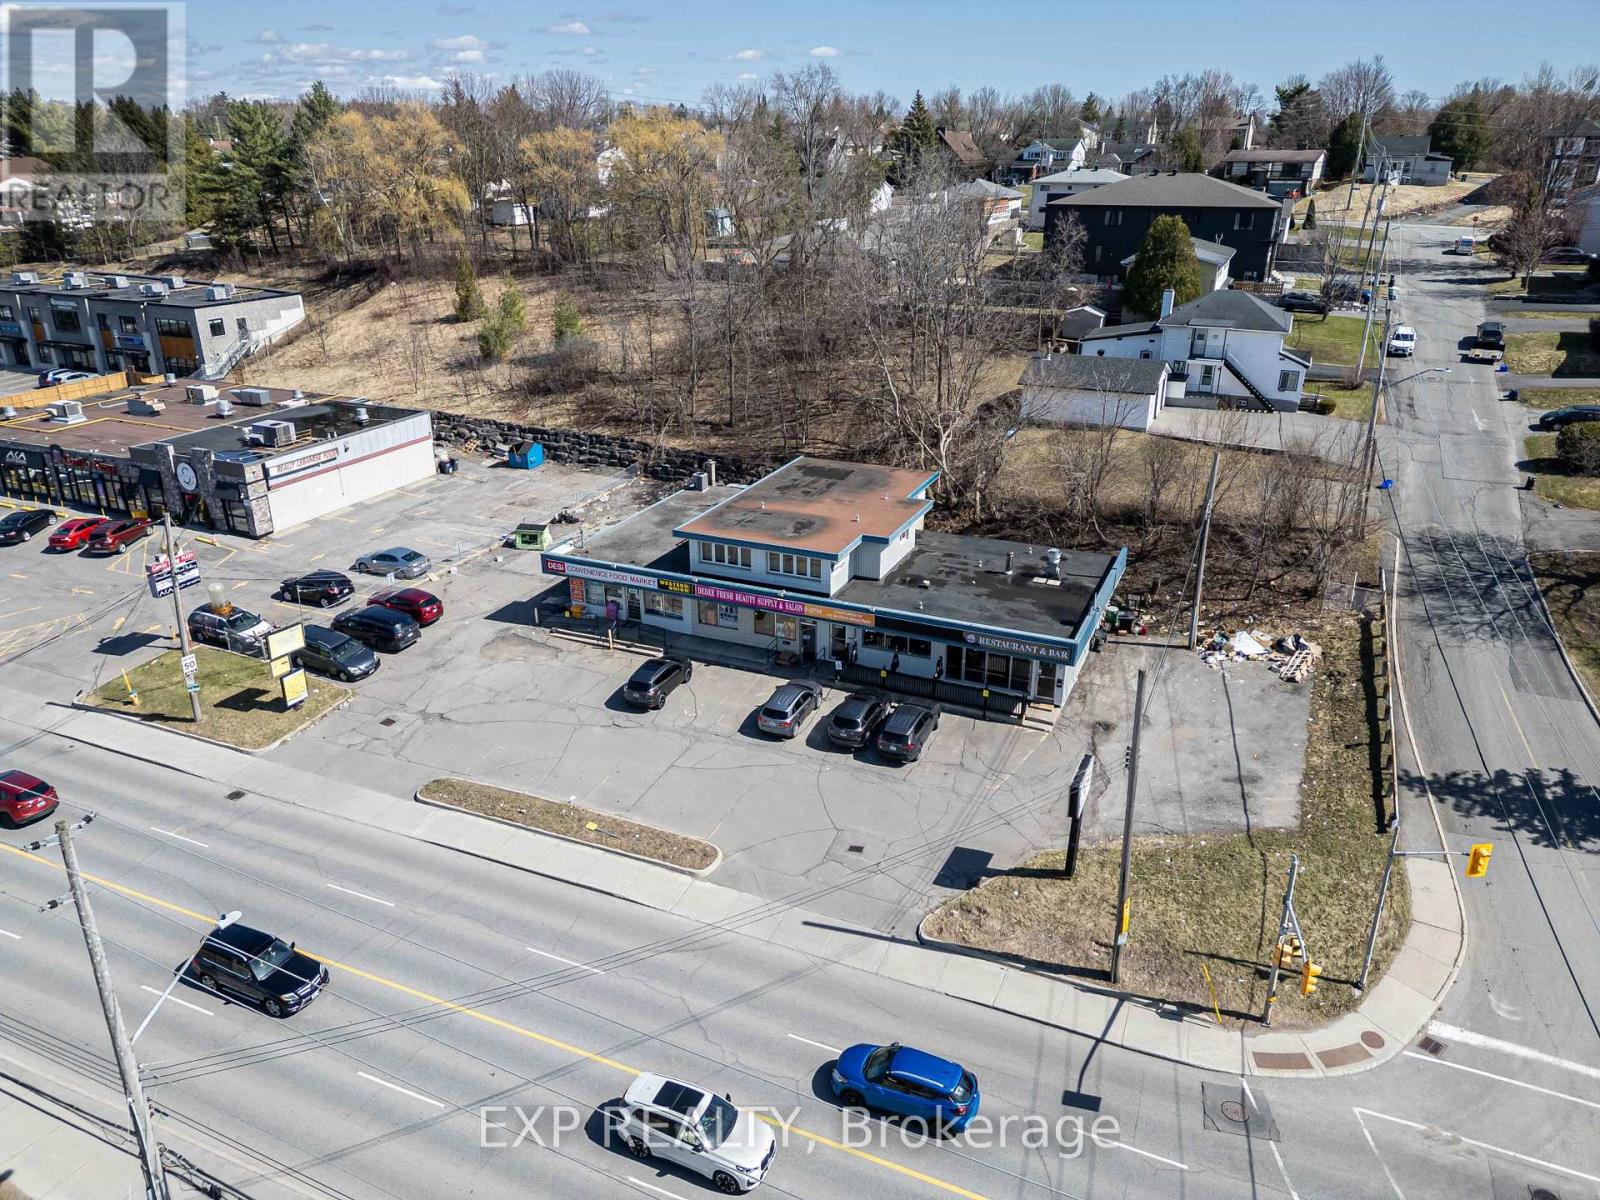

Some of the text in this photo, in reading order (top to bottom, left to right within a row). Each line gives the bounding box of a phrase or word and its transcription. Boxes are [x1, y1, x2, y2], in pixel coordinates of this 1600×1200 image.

[547, 561, 565, 570] DESI
[567, 565, 656, 586] CONVENIENCE FOOD MARKET
[735, 593, 756, 604] BEAUTY
[757, 597, 778, 608] SUPPLY
[785, 604, 804, 614] SALON
[979, 636, 1068, 659] RESTAURANT & BAR
[184, 660, 195, 669] 50
